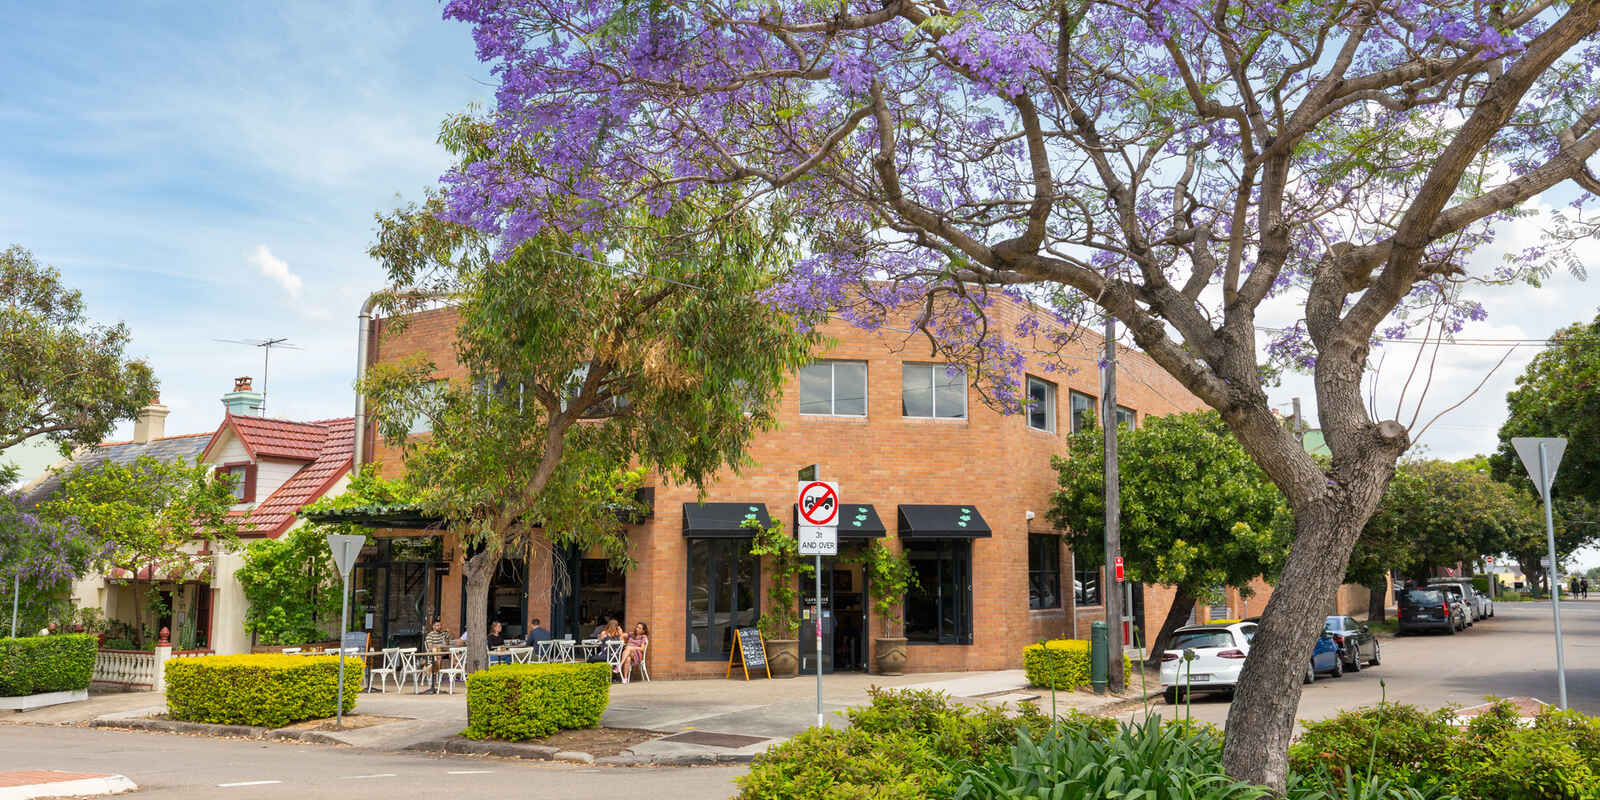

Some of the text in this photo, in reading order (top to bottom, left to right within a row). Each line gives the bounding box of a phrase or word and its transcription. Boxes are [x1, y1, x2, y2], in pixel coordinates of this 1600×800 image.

[815, 531, 823, 539] 3t
[802, 541, 834, 549] AND OVER
